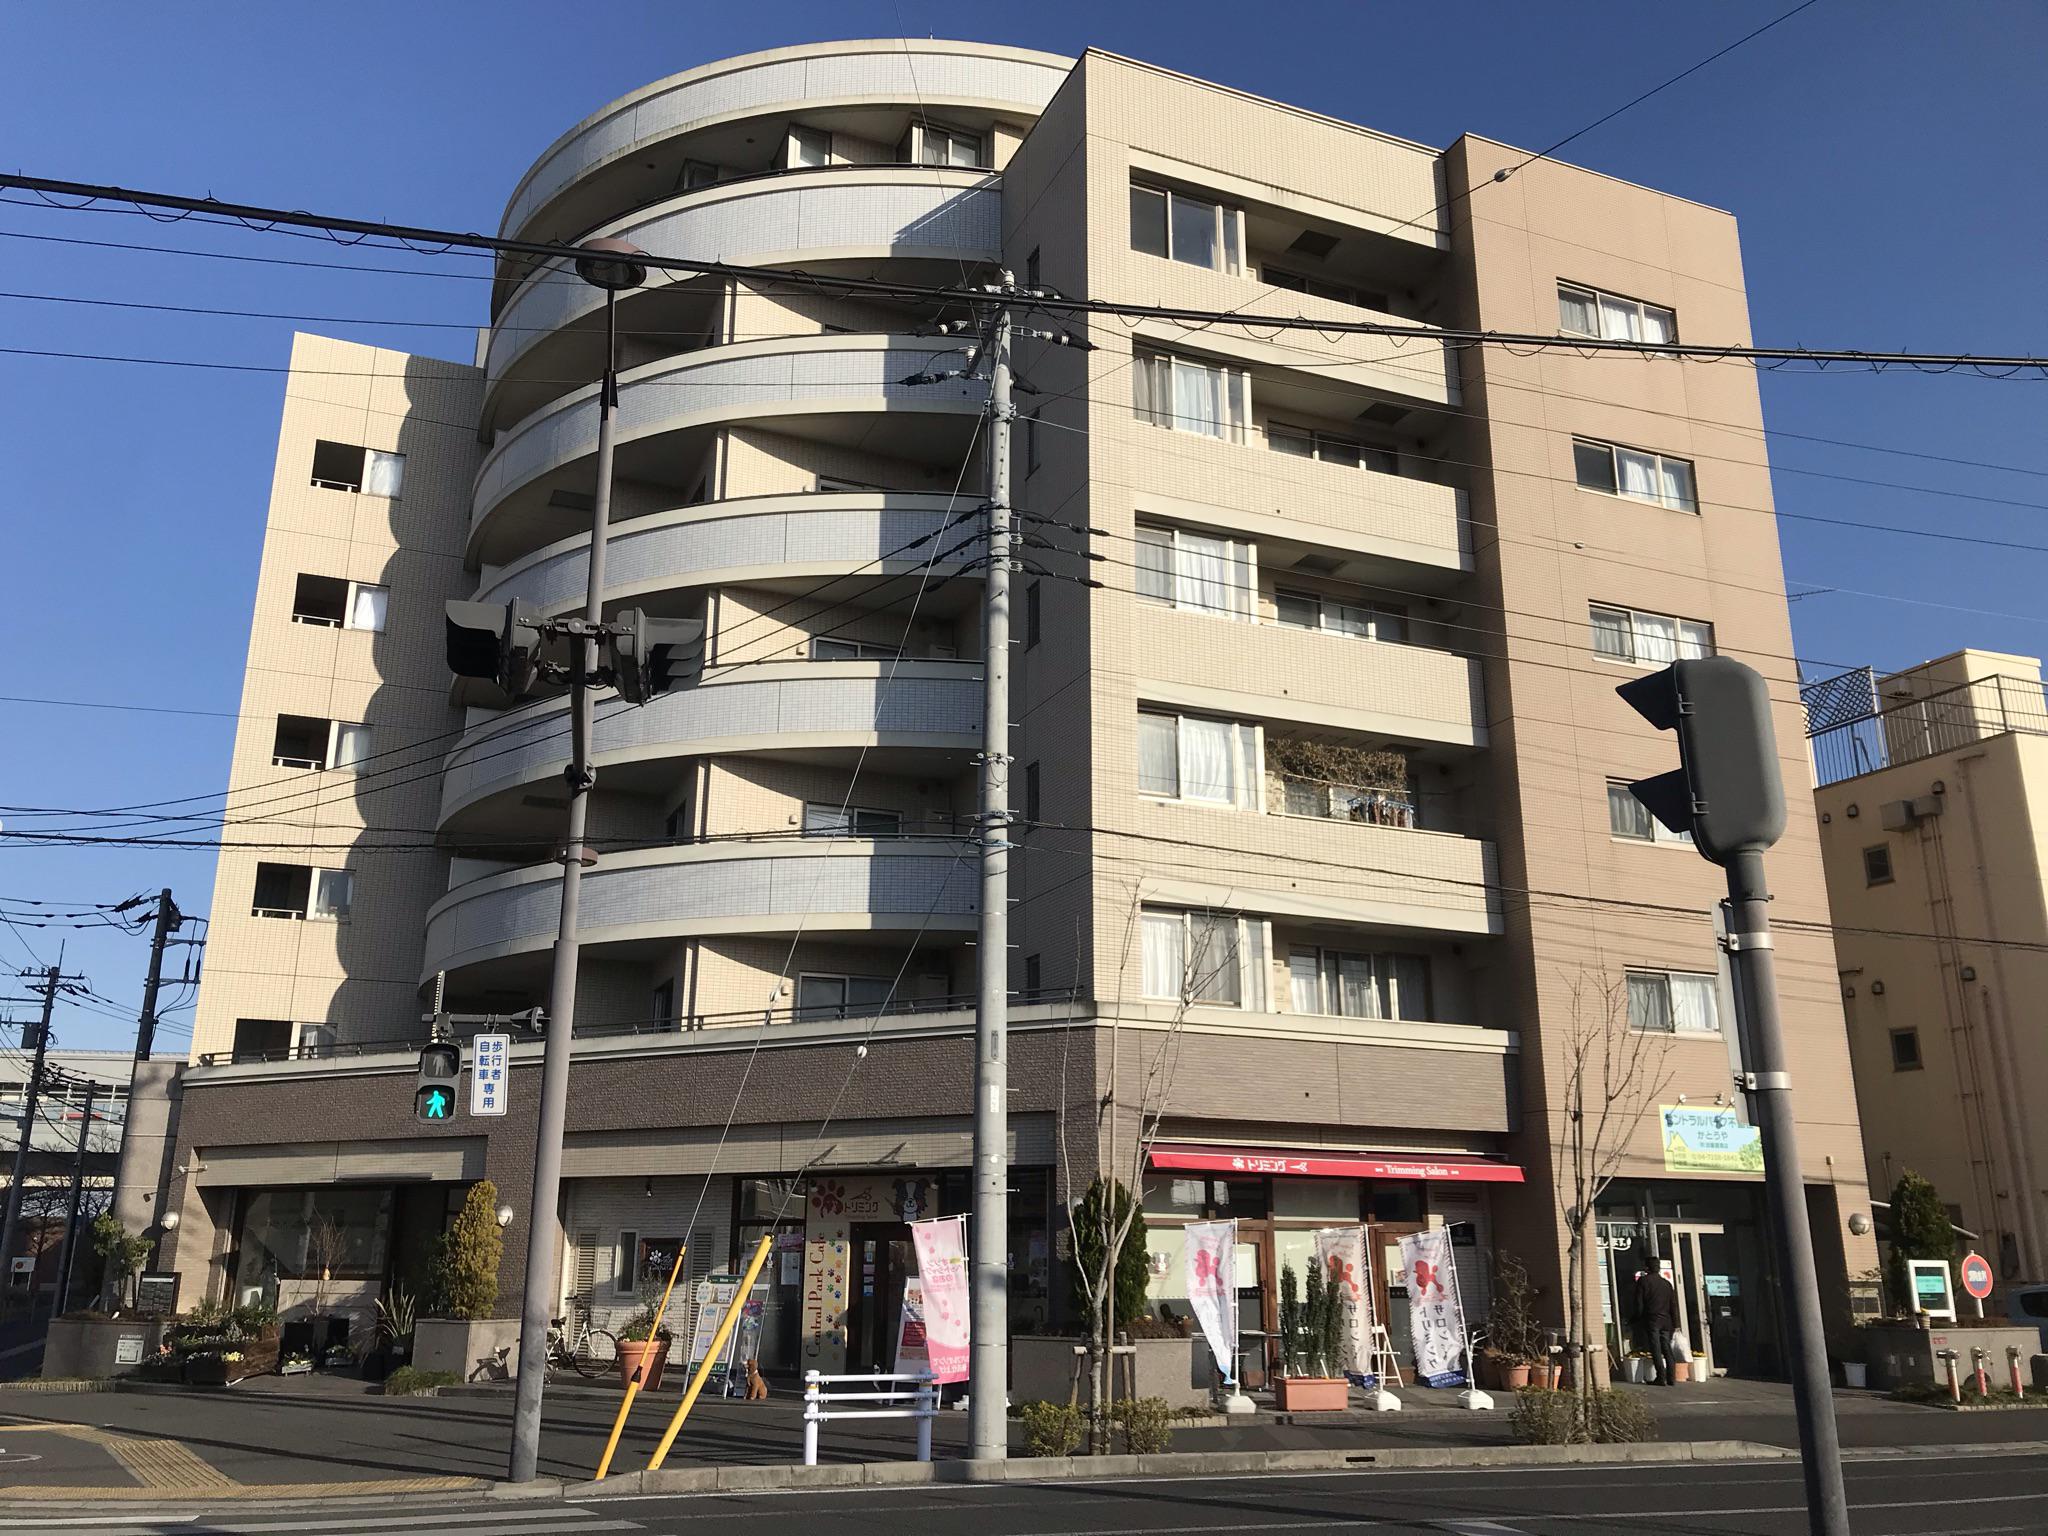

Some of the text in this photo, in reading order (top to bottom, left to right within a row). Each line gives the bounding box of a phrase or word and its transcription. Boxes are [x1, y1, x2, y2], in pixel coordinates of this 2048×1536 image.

[478, 1041, 491, 1081] 自転車
[490, 1040, 503, 1081] 歩行者
[482, 1083, 495, 1109] 専用
[1697, 1131, 1729, 1140] かとうや
[1247, 1159, 1287, 1172] トリミング
[1385, 1164, 1449, 1178] Trimming Salon
[805, 1232, 826, 1358] Central Park Cafe
